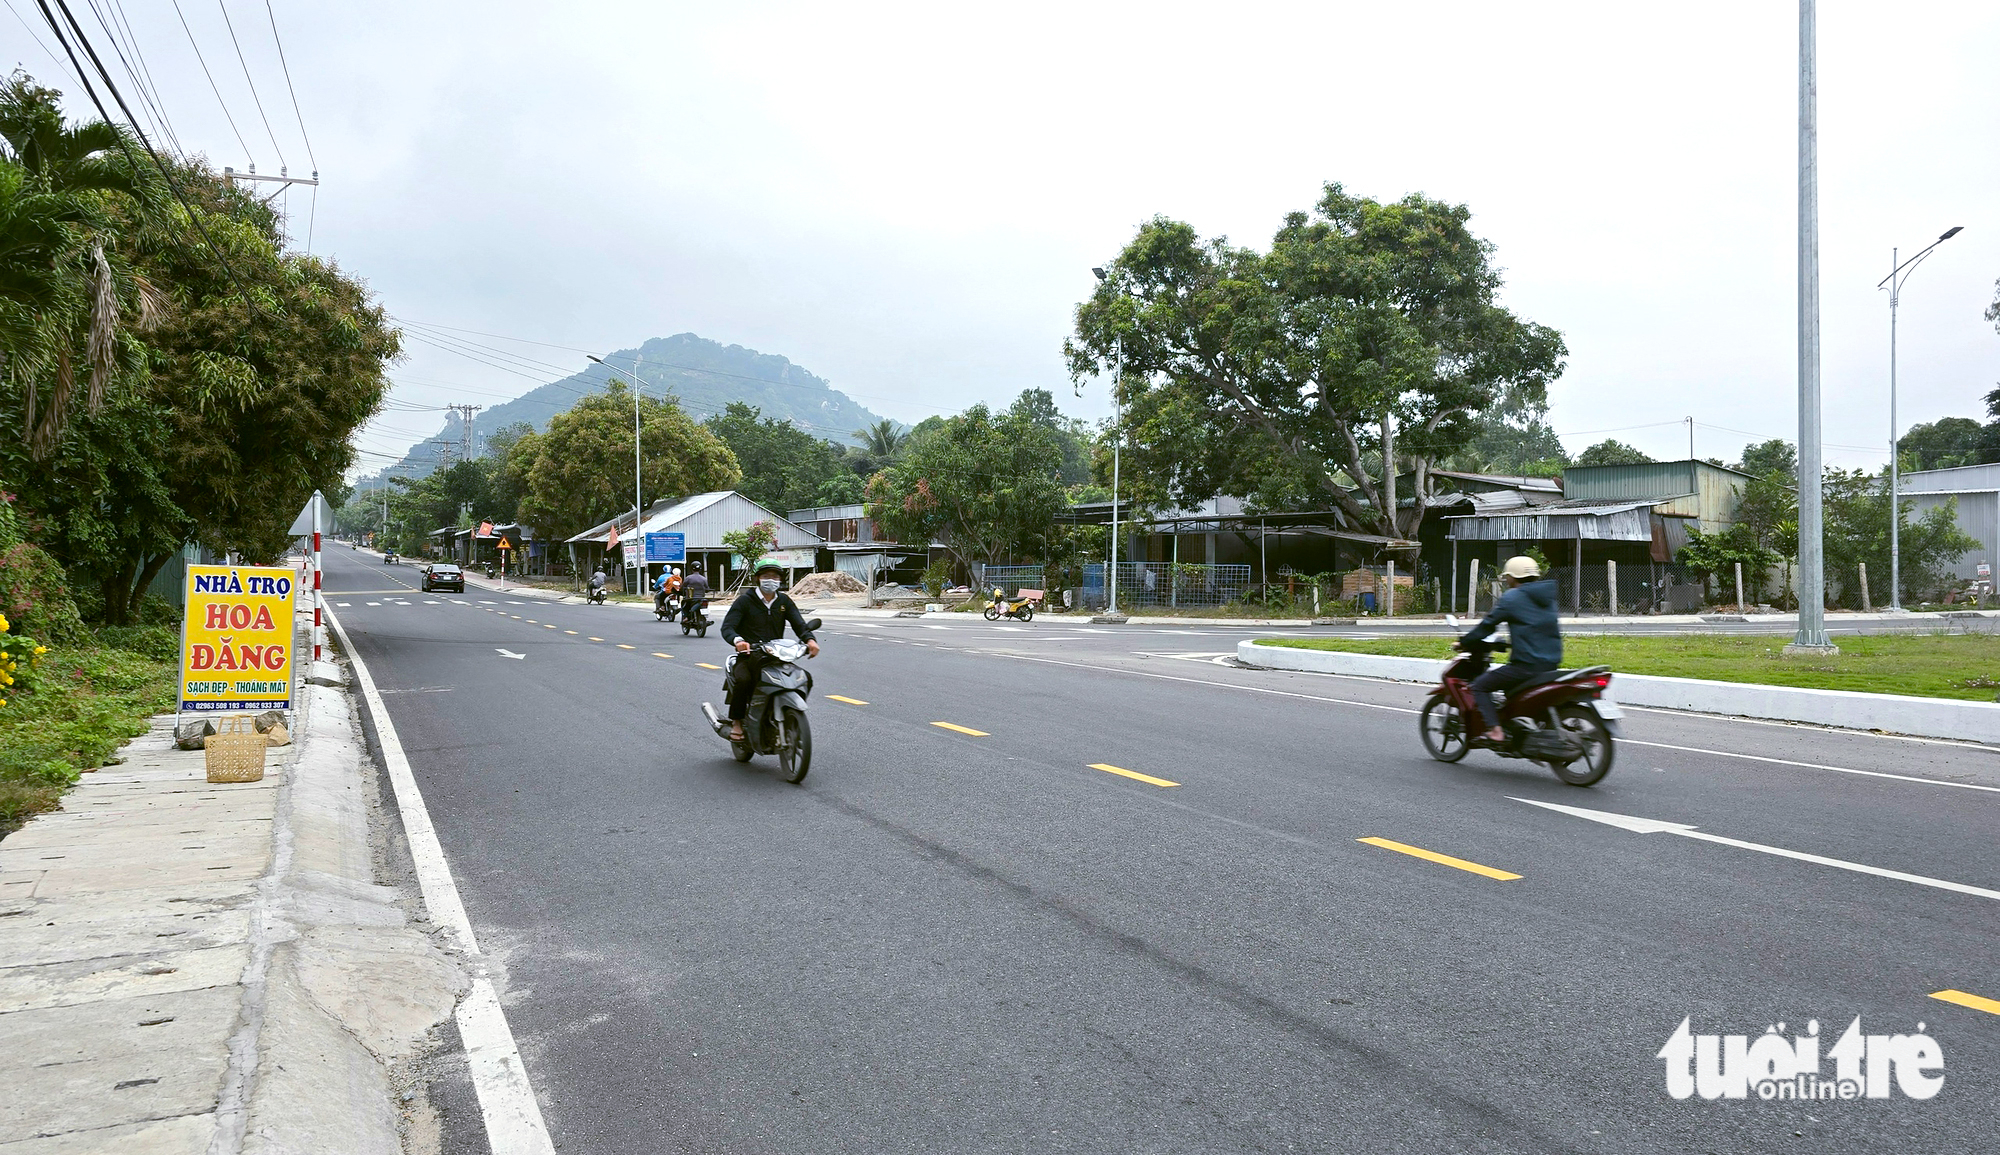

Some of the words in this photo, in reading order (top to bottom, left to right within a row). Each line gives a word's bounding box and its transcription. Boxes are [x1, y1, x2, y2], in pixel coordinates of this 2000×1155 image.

[194, 571, 242, 594] NHÀ
[248, 577, 291, 600] TRỌ
[204, 604, 276, 630] HOA
[190, 636, 287, 671] ĐĂNG
[187, 681, 210, 695] SẠCH
[211, 681, 228, 695] ĐẸP
[235, 679, 267, 693] THOÁNG
[269, 679, 287, 693] MÁT
[195, 702, 215, 710] 02963
